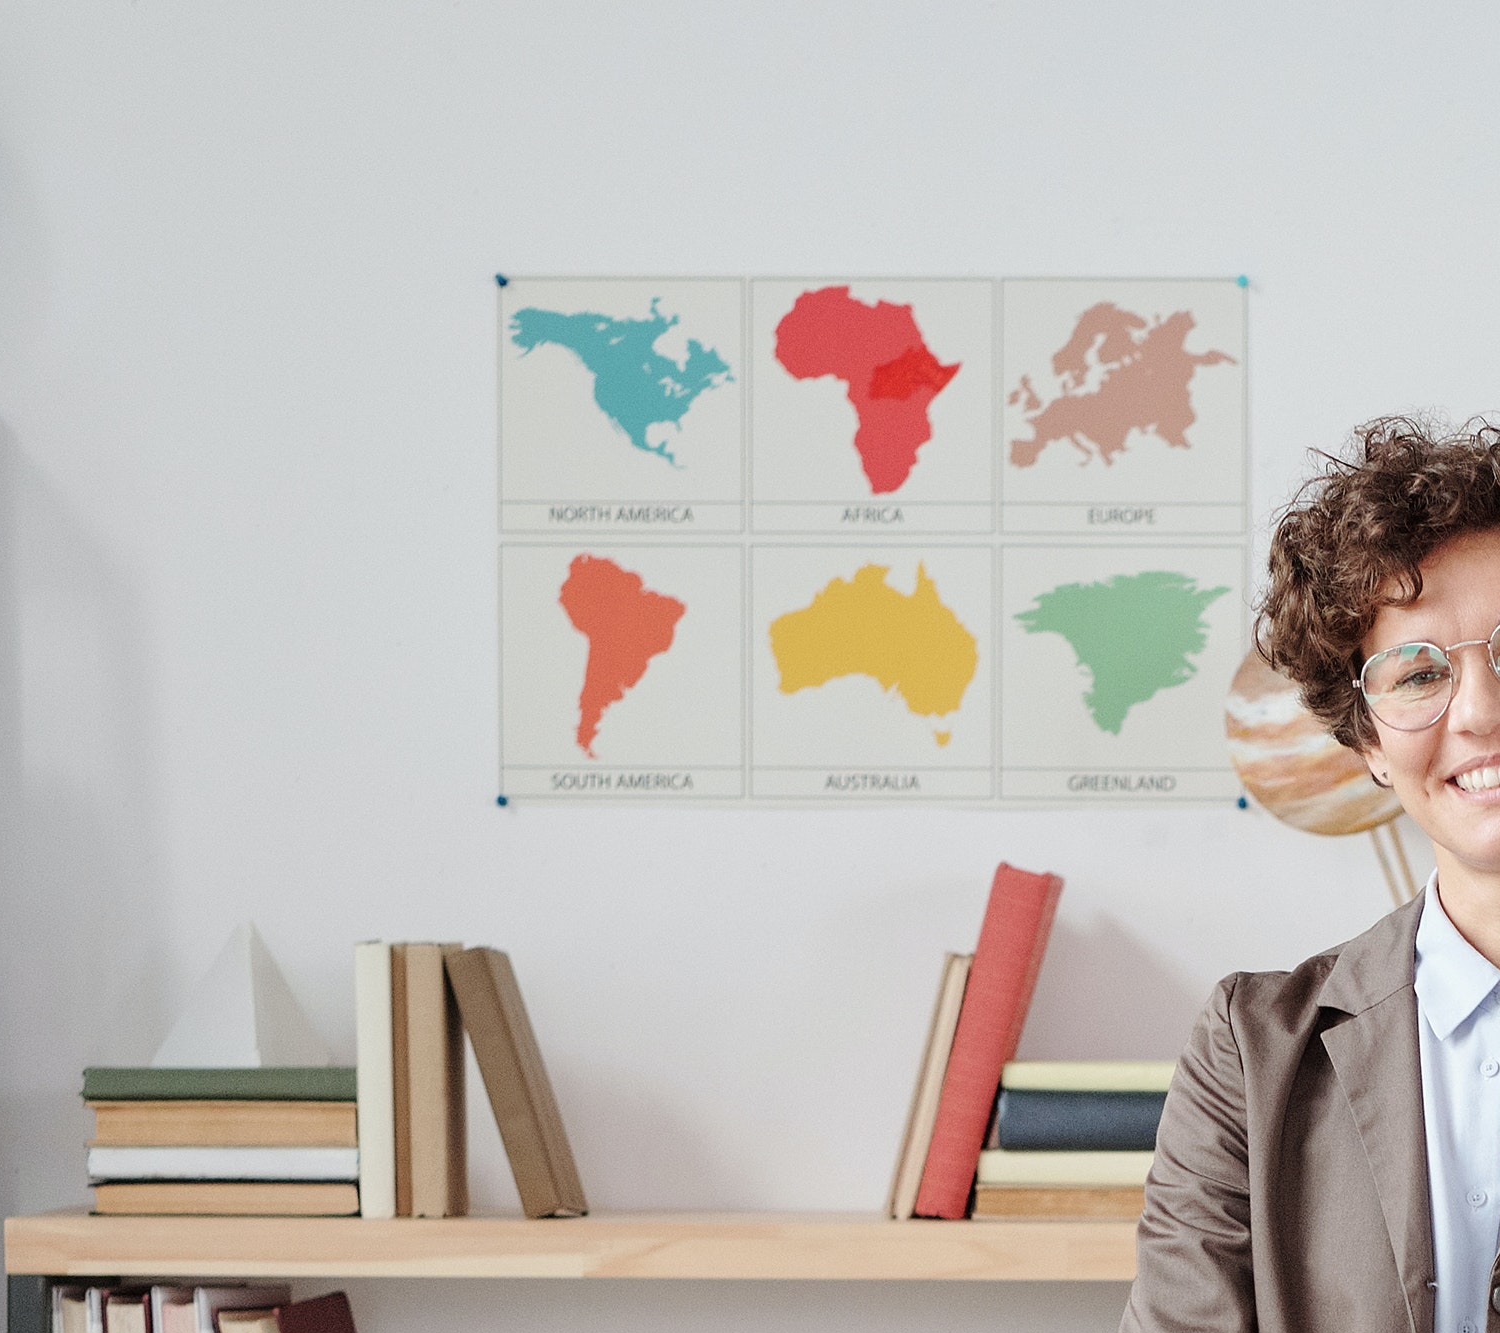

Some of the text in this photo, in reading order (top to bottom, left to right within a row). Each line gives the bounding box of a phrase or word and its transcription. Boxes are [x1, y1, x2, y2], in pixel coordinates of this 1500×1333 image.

[549, 506, 695, 523] NORTH AMERICA
[840, 507, 905, 523] AFRICA
[1086, 507, 1157, 524] EUROPE
[550, 773, 694, 790] SOUTH AMERICA
[824, 774, 920, 791] AUSTRALIA
[1067, 774, 1177, 792] GREENLAND
